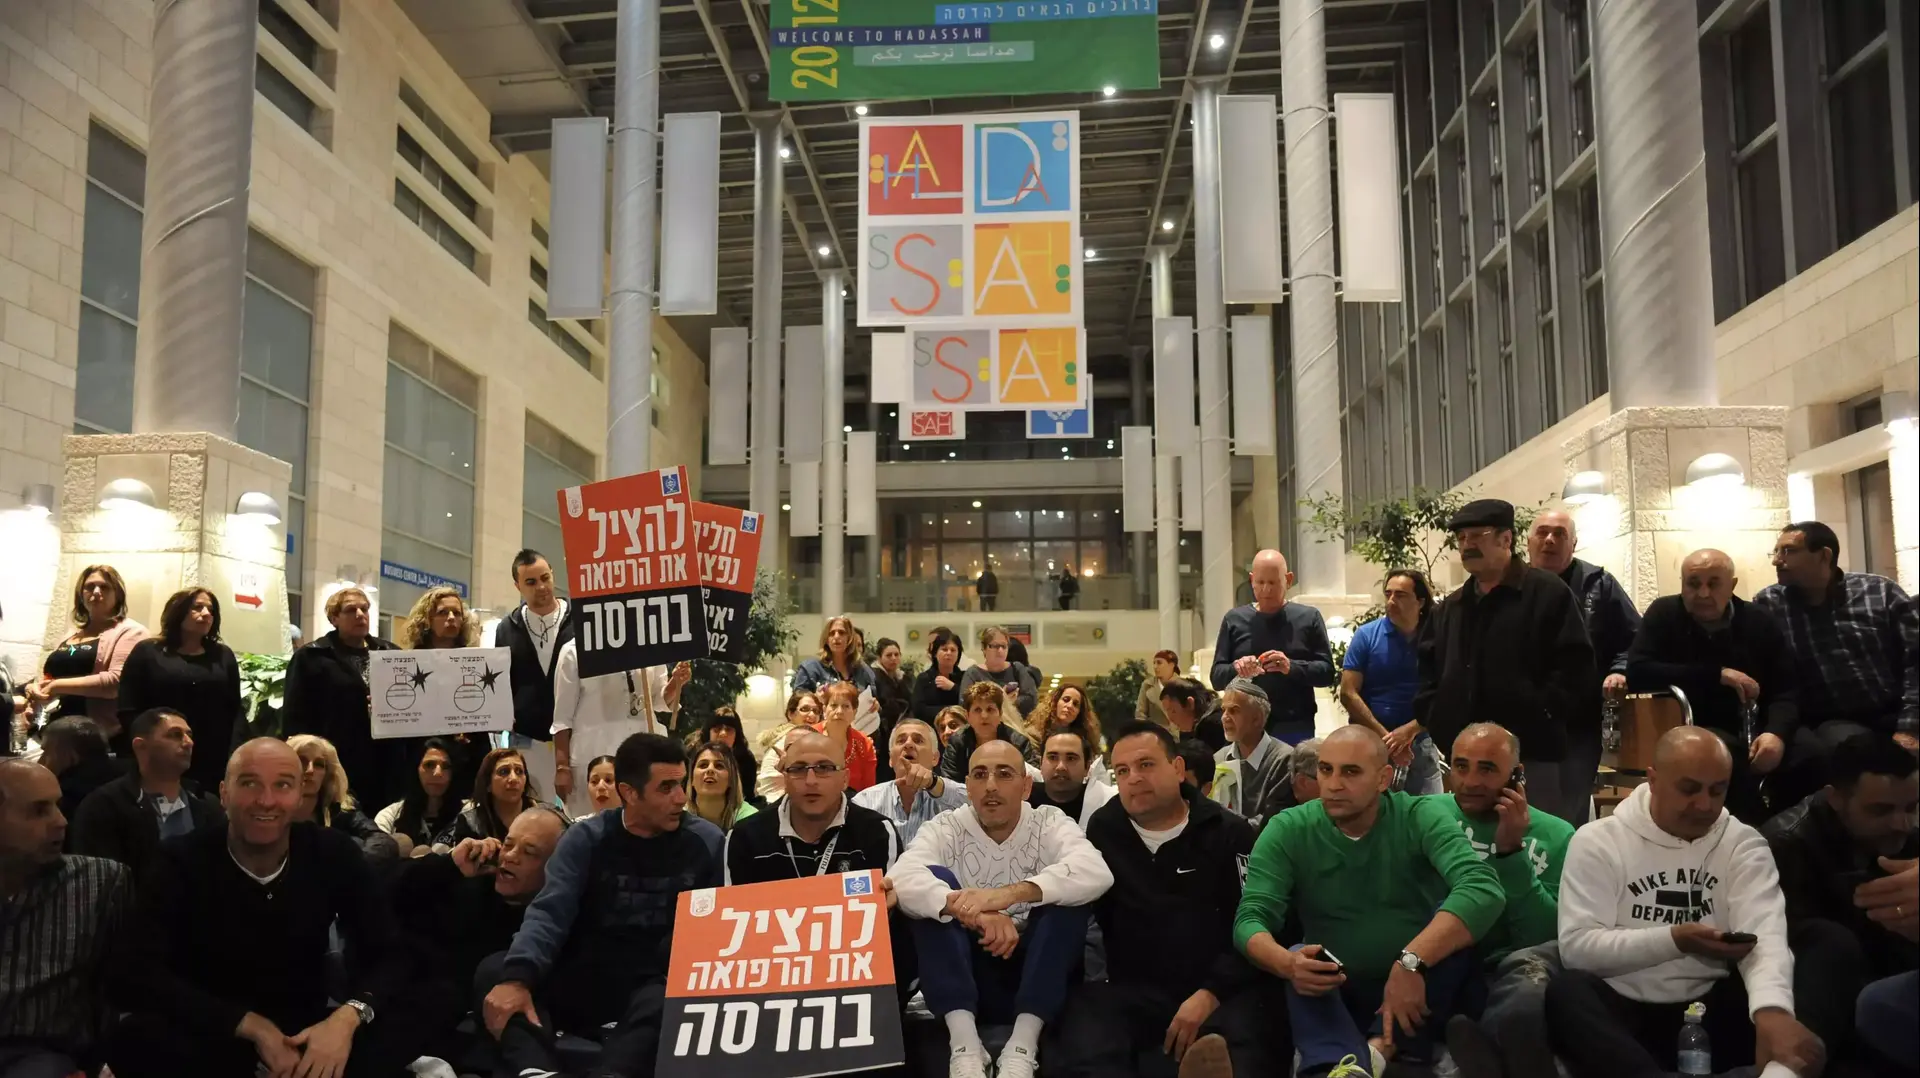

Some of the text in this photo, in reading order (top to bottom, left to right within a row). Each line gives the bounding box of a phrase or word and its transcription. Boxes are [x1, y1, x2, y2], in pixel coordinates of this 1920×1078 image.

[944, 0, 1150, 20] ברוכים הבאים להדסה
[778, 27, 983, 43] WELCOME TO HADASSAH
[791, 0, 838, 89] 2012
[587, 498, 686, 559] להציל
[580, 553, 688, 592] את הרפואה
[582, 593, 692, 652] בהדסה
[820, 843, 834, 870] FUJIFILM
[1627, 871, 1669, 898] NIKE
[718, 898, 878, 957] להציל
[687, 951, 874, 991] את הרפואה
[673, 993, 875, 1057] בהדסה
